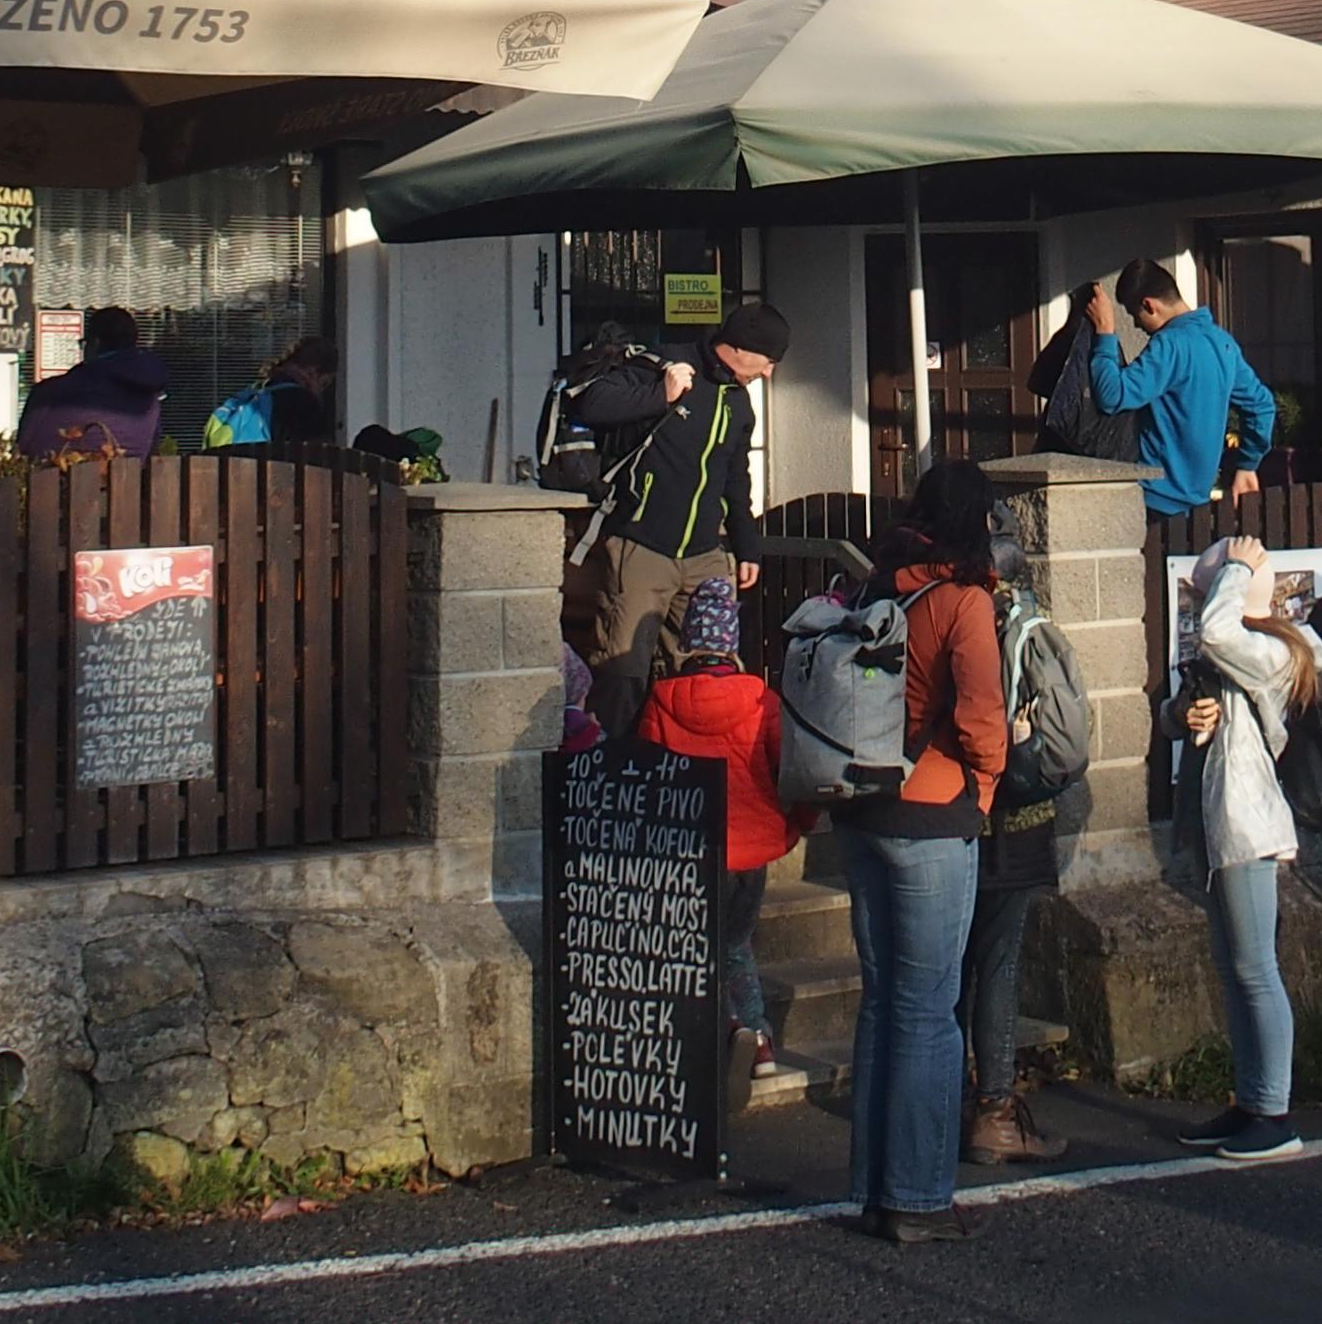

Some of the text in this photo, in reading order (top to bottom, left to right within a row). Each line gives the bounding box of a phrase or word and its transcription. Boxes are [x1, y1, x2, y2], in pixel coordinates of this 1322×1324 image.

[138, 5, 250, 44] 1753
[668, 280, 709, 291] BISTRO
[678, 299, 718, 310] PRODEJNA
[657, 786, 706, 821] PIVO
[578, 851, 698, 893] MALINOVKA
